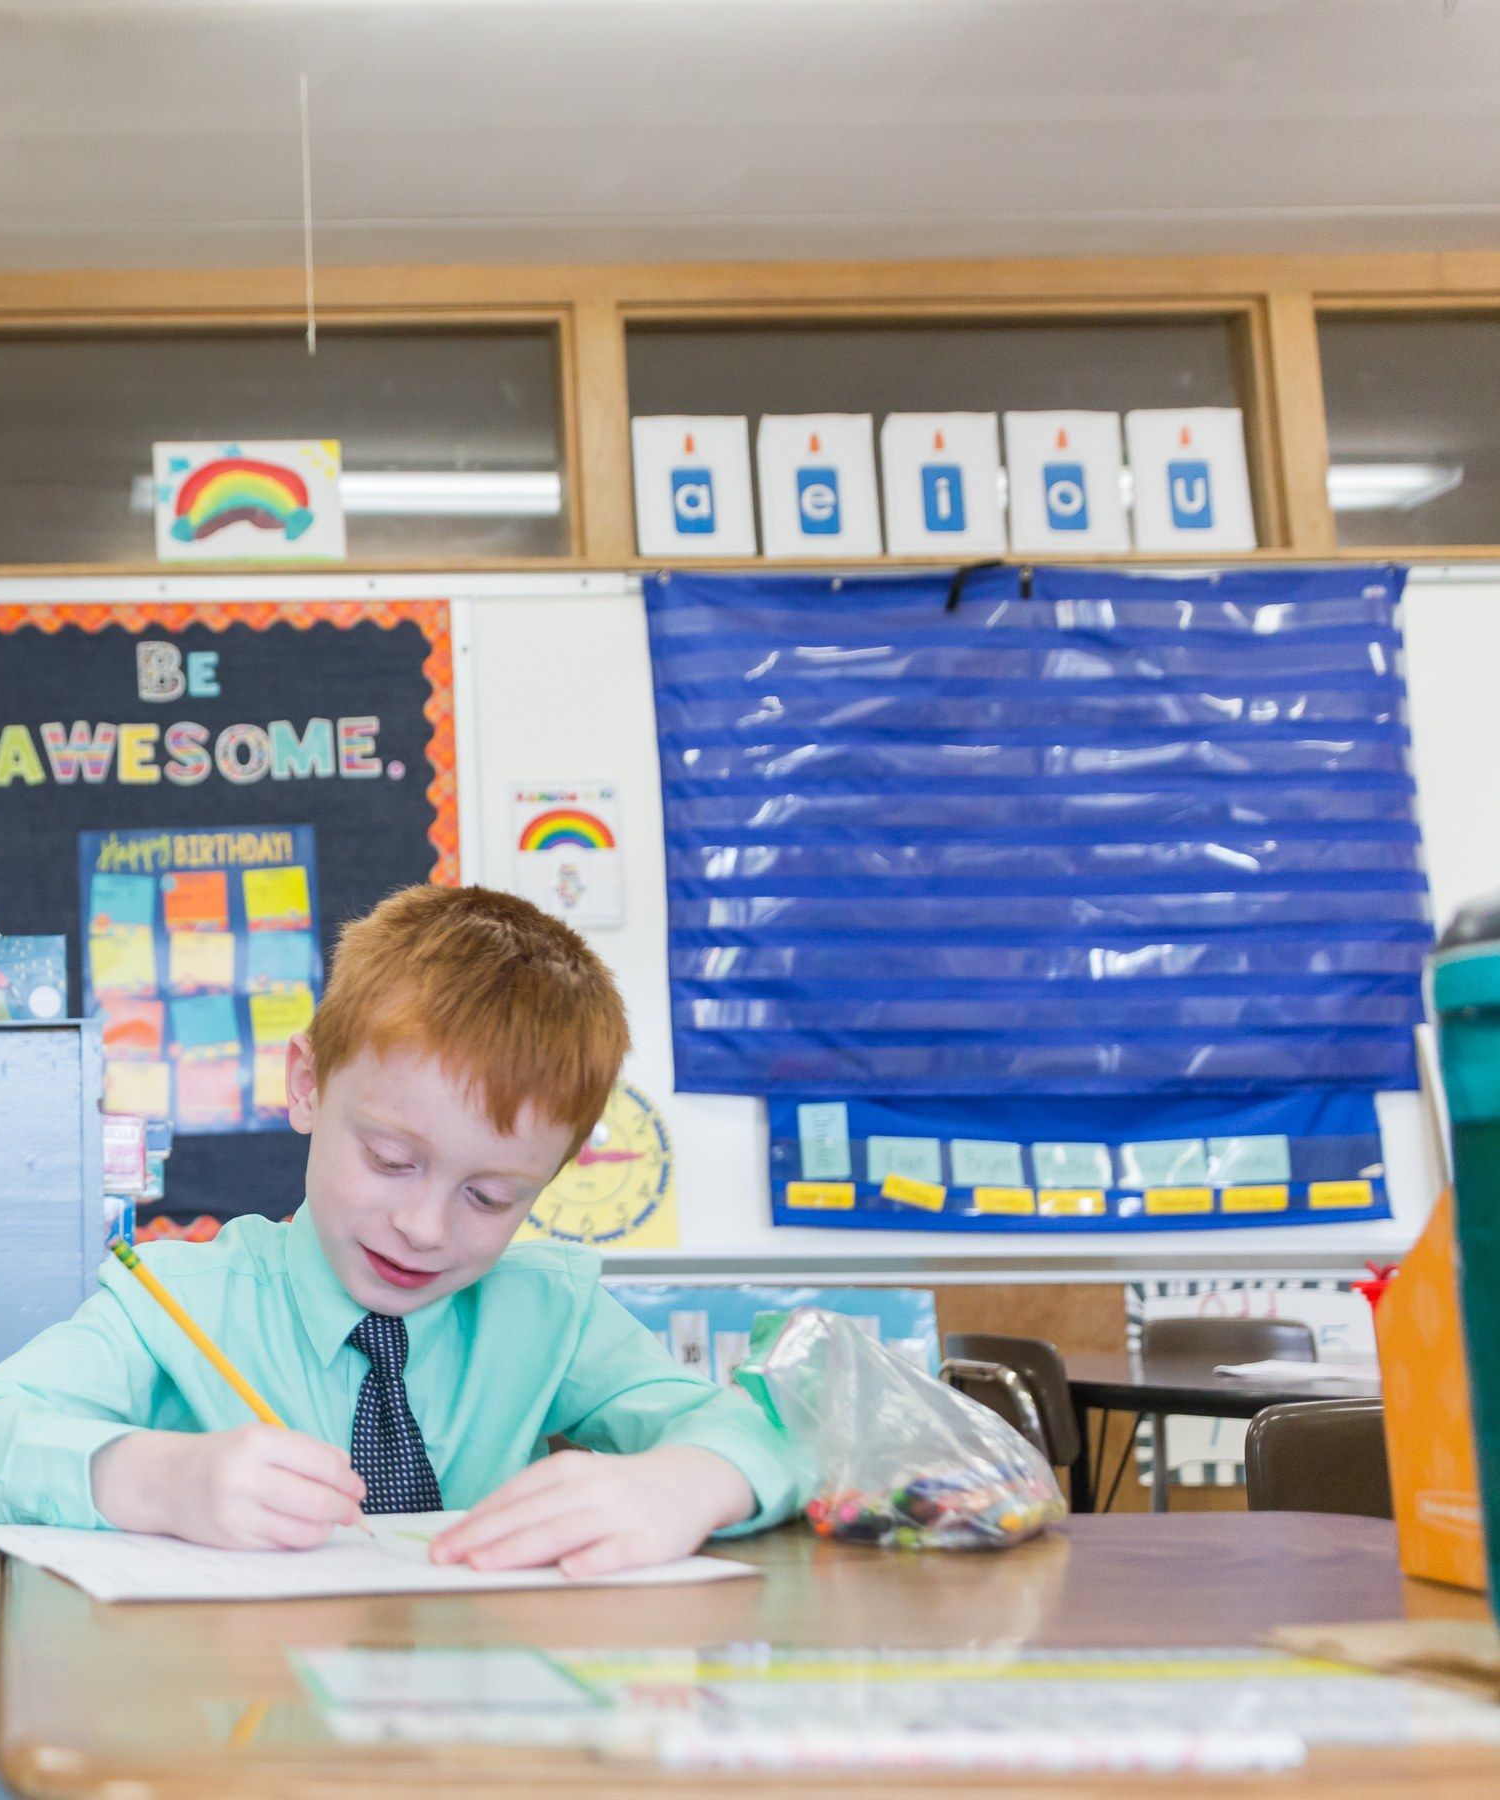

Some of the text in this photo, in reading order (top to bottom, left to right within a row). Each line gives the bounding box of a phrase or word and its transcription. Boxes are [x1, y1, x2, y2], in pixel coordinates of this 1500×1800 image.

[674, 482, 712, 519] a
[800, 482, 838, 519] e
[935, 477, 951, 519] i
[1047, 480, 1084, 517] o
[135, 640, 221, 702] BE
